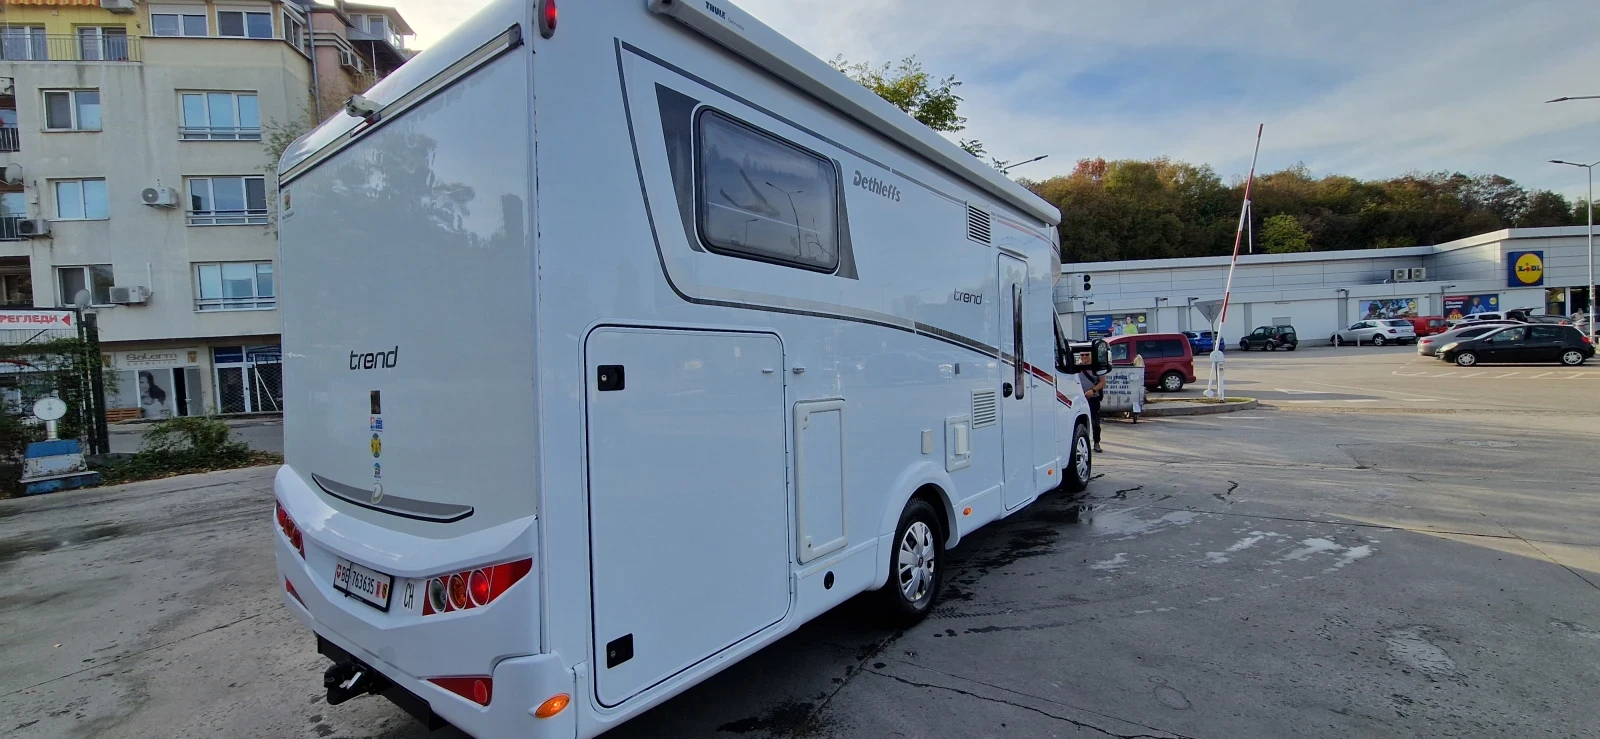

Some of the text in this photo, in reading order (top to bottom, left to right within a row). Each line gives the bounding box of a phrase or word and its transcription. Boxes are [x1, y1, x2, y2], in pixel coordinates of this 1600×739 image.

[705, 0, 726, 20] THULE
[853, 169, 901, 202] Dethleffs
[953, 288, 983, 305] trend
[350, 345, 399, 370] trend
[352, 570, 375, 595] 763635
[403, 582, 415, 609] CH
